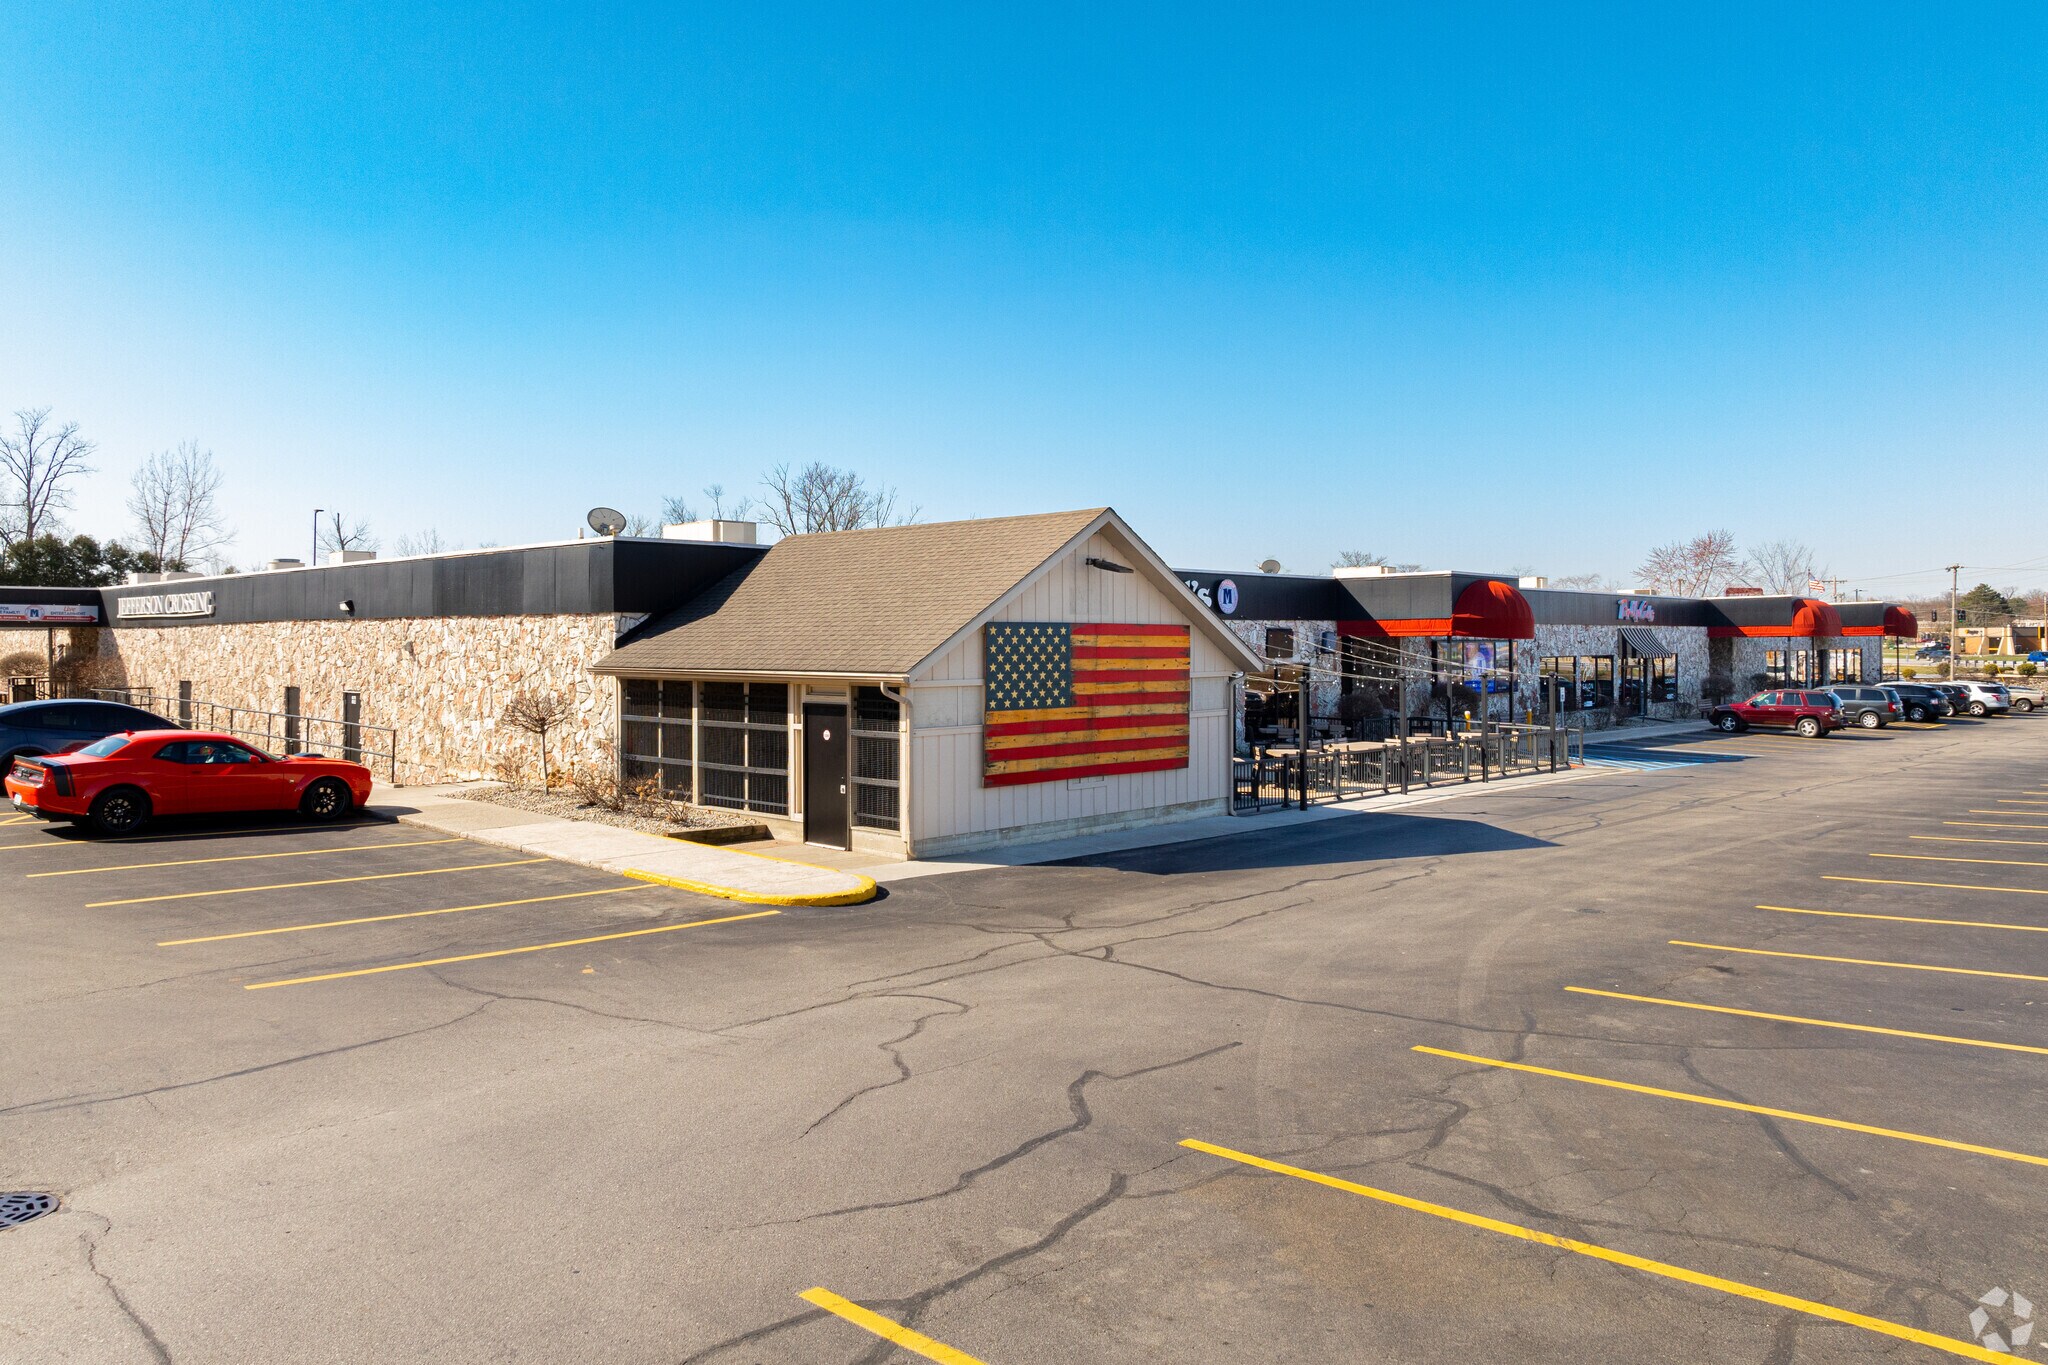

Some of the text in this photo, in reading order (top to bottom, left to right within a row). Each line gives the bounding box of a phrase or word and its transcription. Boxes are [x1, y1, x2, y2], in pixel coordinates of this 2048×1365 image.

[117, 591, 216, 615] JEFFERSON CROSSING
[1185, 580, 1212, 607] 's
[1223, 588, 1232, 605] M
[30, 609, 39, 617] M
